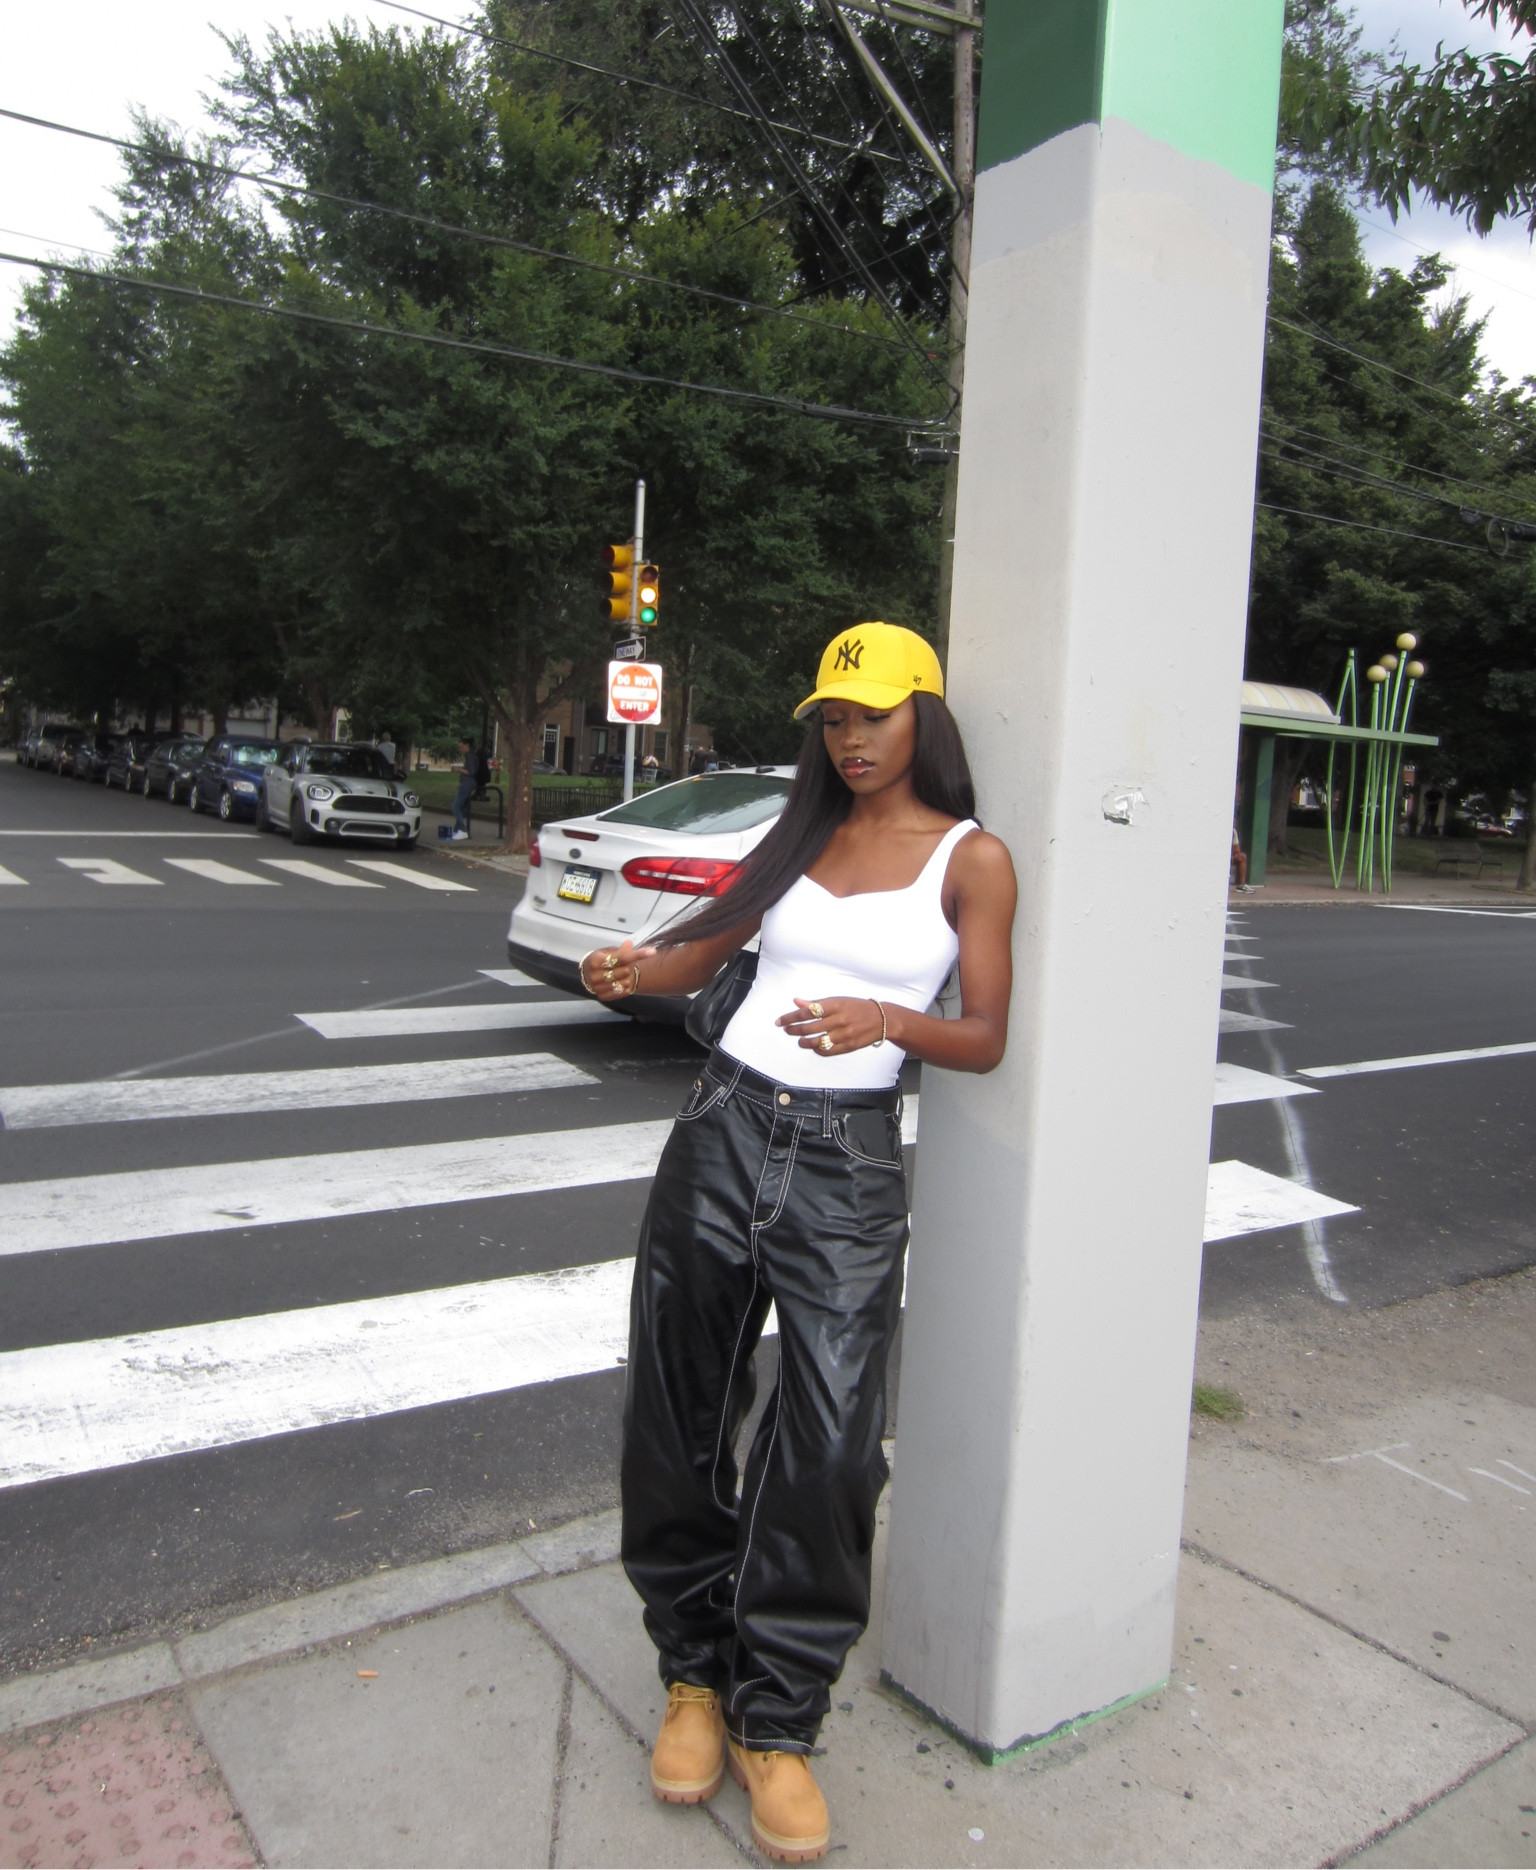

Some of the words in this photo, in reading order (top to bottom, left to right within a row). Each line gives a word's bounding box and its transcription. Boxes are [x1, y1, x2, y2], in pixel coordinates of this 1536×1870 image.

[617, 647, 626, 658] ONE
[626, 646, 635, 656] WAY
[834, 639, 864, 671] NY
[617, 674, 630, 685] DO
[635, 676, 653, 687] NOT
[620, 701, 650, 712] ENTER
